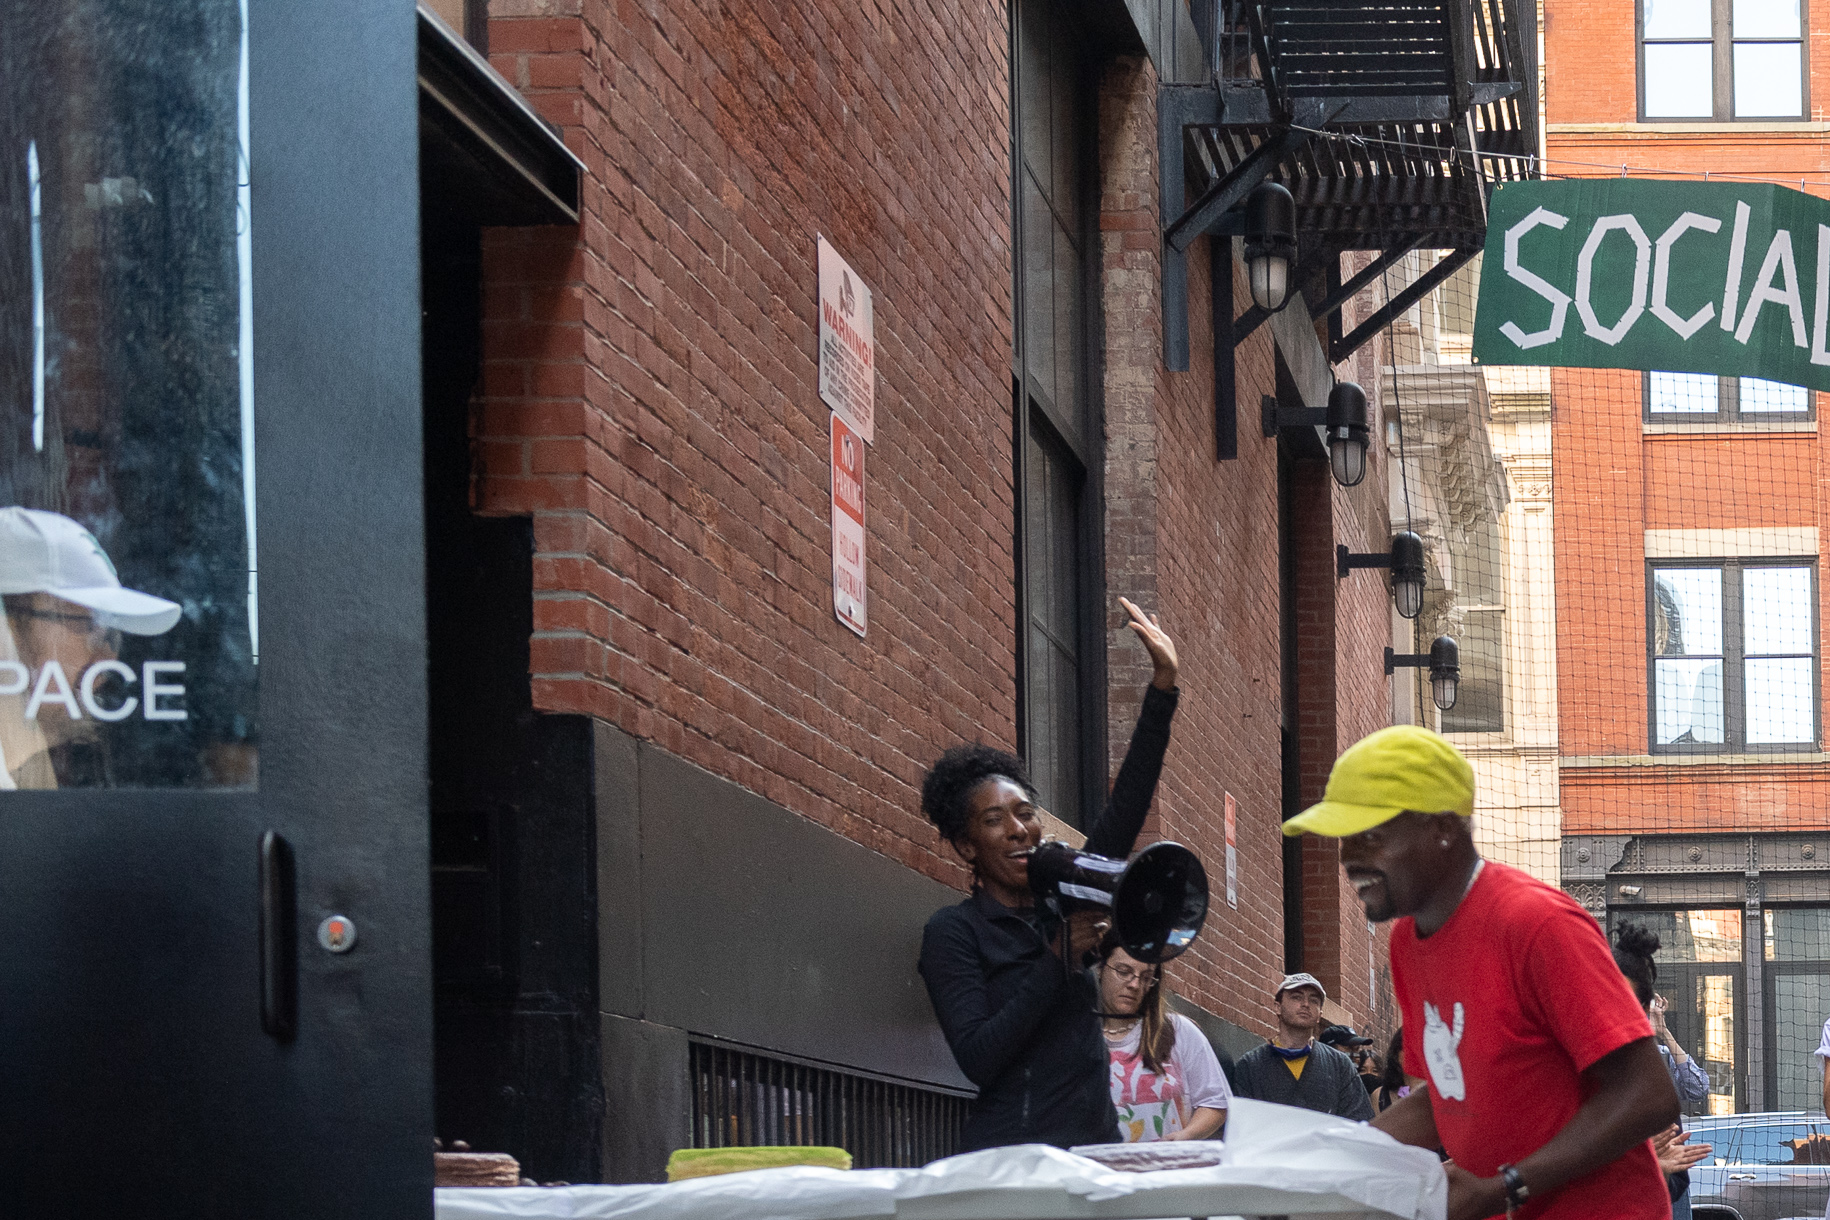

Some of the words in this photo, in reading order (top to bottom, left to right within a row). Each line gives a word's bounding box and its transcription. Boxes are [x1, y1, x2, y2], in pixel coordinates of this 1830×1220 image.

[822, 296, 871, 370] WARNING!
[841, 432, 854, 474] NO
[835, 464, 861, 515] PARKING
[838, 562, 861, 606] SIDEWALK
